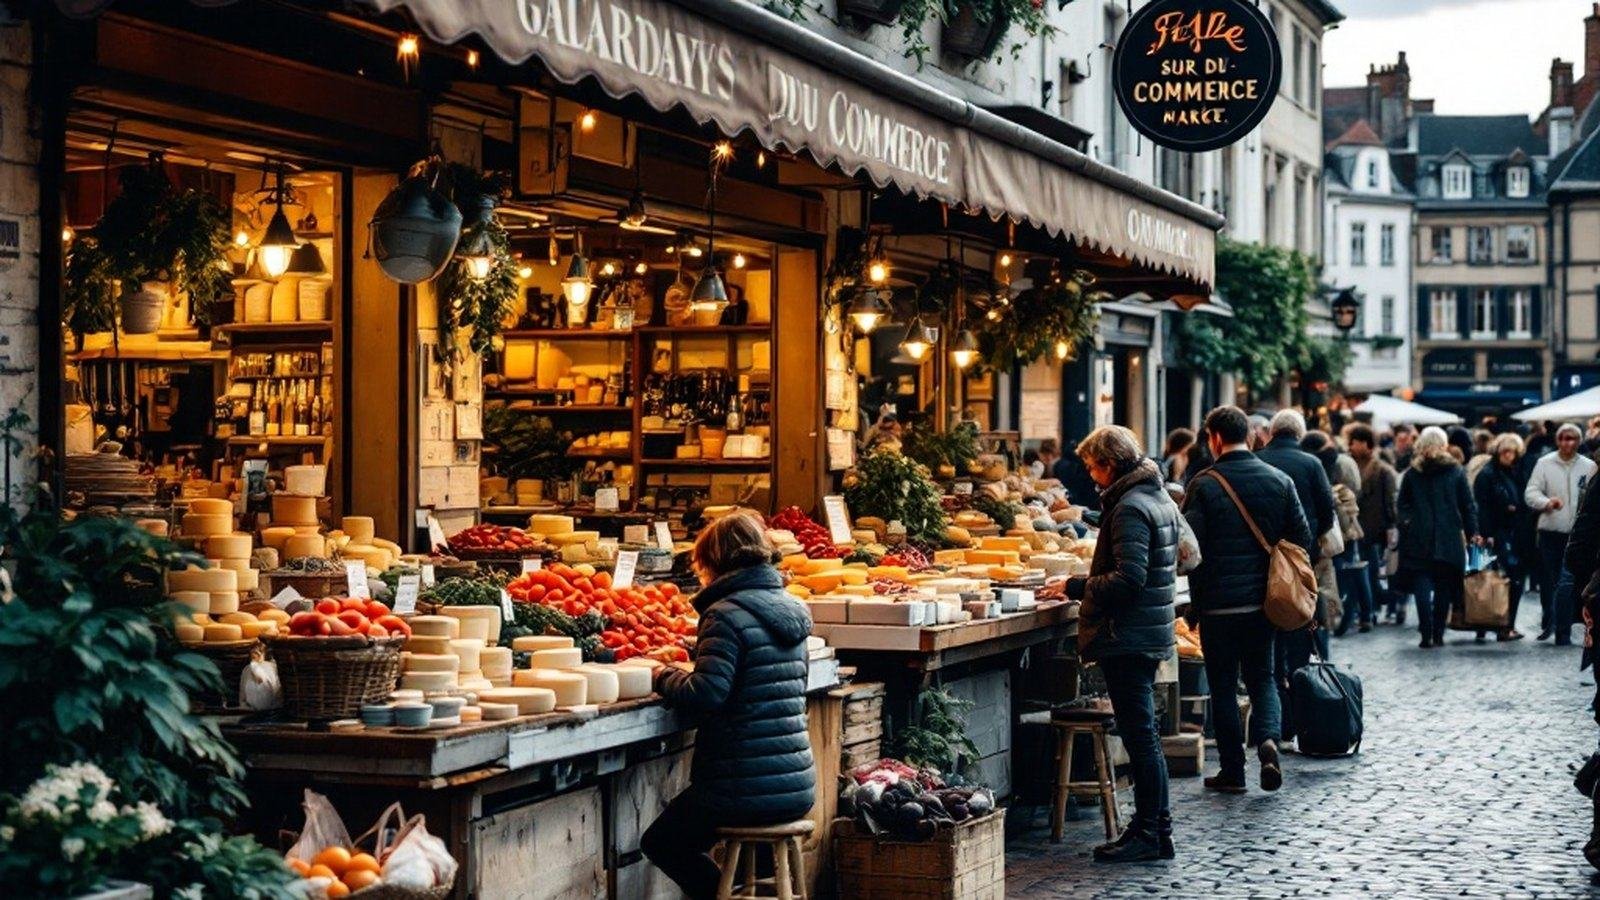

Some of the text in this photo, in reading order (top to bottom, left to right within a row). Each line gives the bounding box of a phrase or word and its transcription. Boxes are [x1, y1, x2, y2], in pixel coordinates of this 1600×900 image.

[1161, 59, 1198, 76] SUR
[1133, 79, 1258, 103] COMMERCE
[828, 91, 950, 184] COMMERCE
